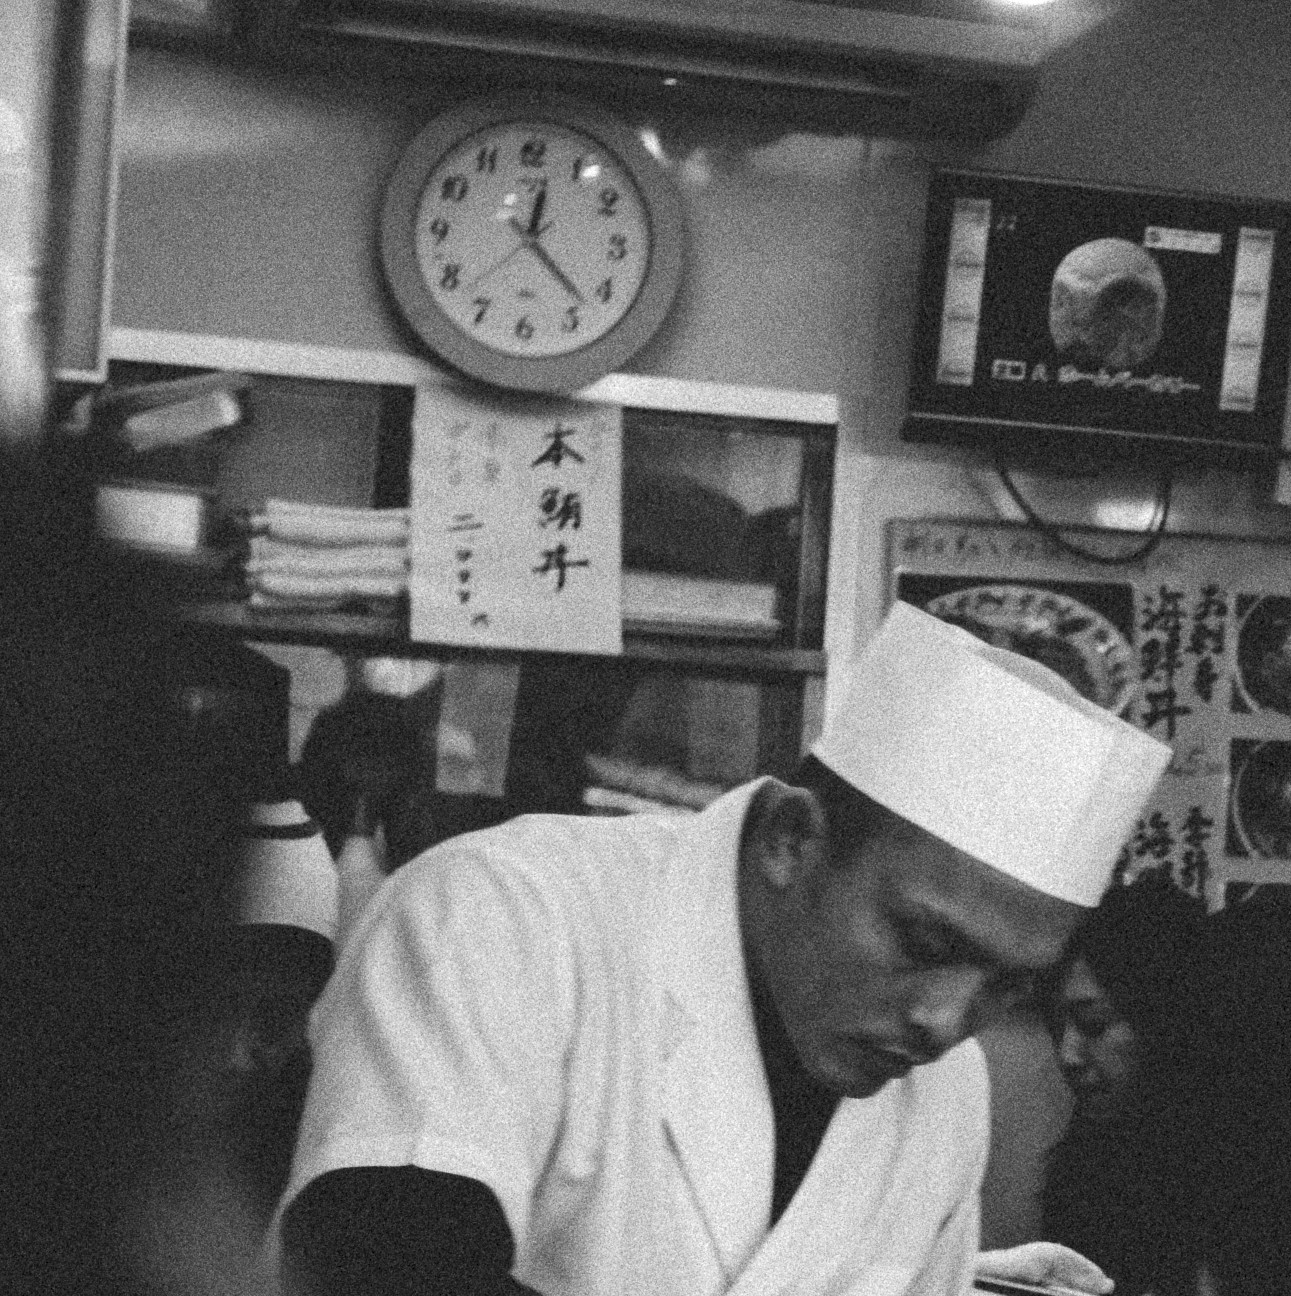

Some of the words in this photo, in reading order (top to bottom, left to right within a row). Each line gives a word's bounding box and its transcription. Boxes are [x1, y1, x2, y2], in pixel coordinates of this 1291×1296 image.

[476, 147, 498, 174] 11
[519, 139, 547, 168] 12
[441, 175, 469, 202] 10
[599, 187, 619, 217] 2
[430, 218, 449, 244] 9
[607, 234, 628, 261] 3
[439, 263, 461, 291] 8
[597, 276, 613, 304] 4
[472, 298, 491, 325] 7
[562, 305, 579, 333] 5
[514, 316, 535, 341] 6
